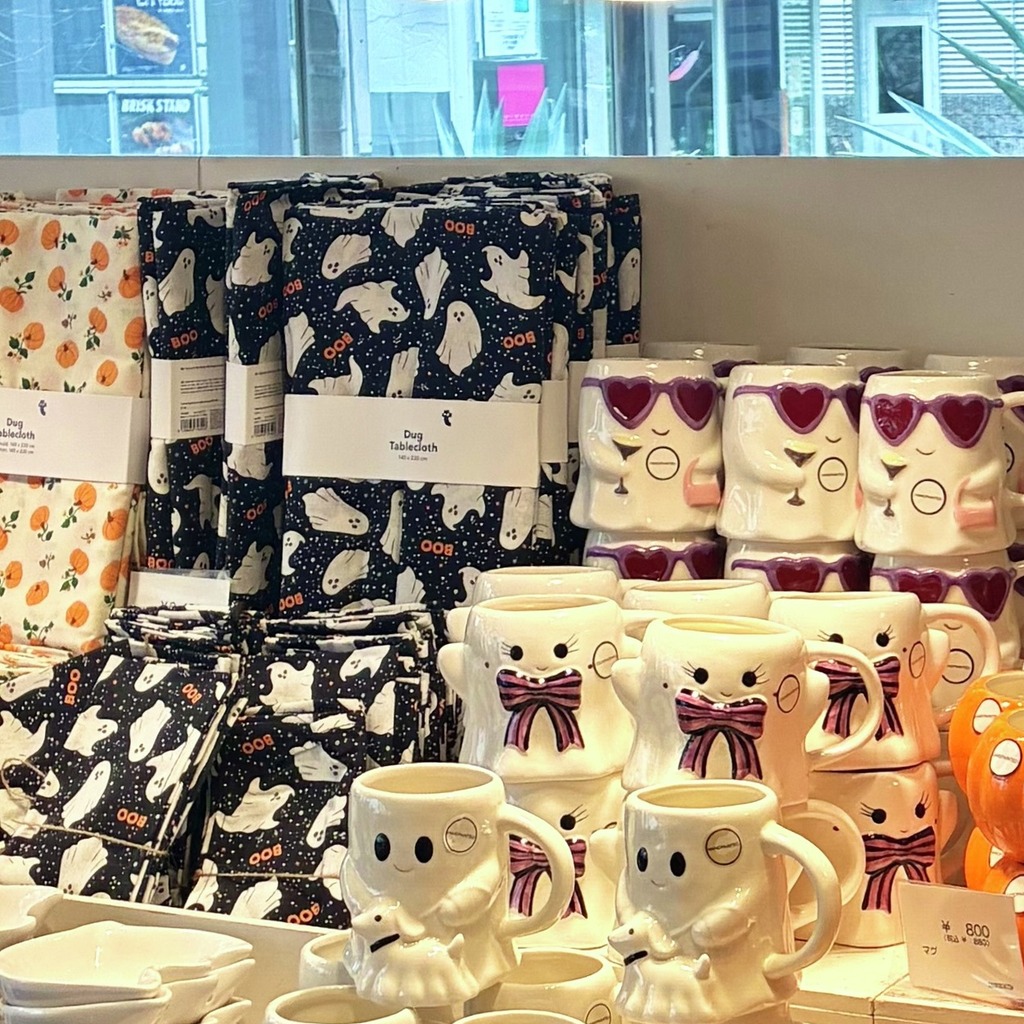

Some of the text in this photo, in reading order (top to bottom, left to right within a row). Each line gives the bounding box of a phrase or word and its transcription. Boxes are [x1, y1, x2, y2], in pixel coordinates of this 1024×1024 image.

[170, 329, 198, 349] BOO
[6, 417, 24, 430] Dug
[403, 429, 423, 442] Dug
[389, 440, 438, 453] Tablecloth
[941, 919, 991, 939] ¥ 800
